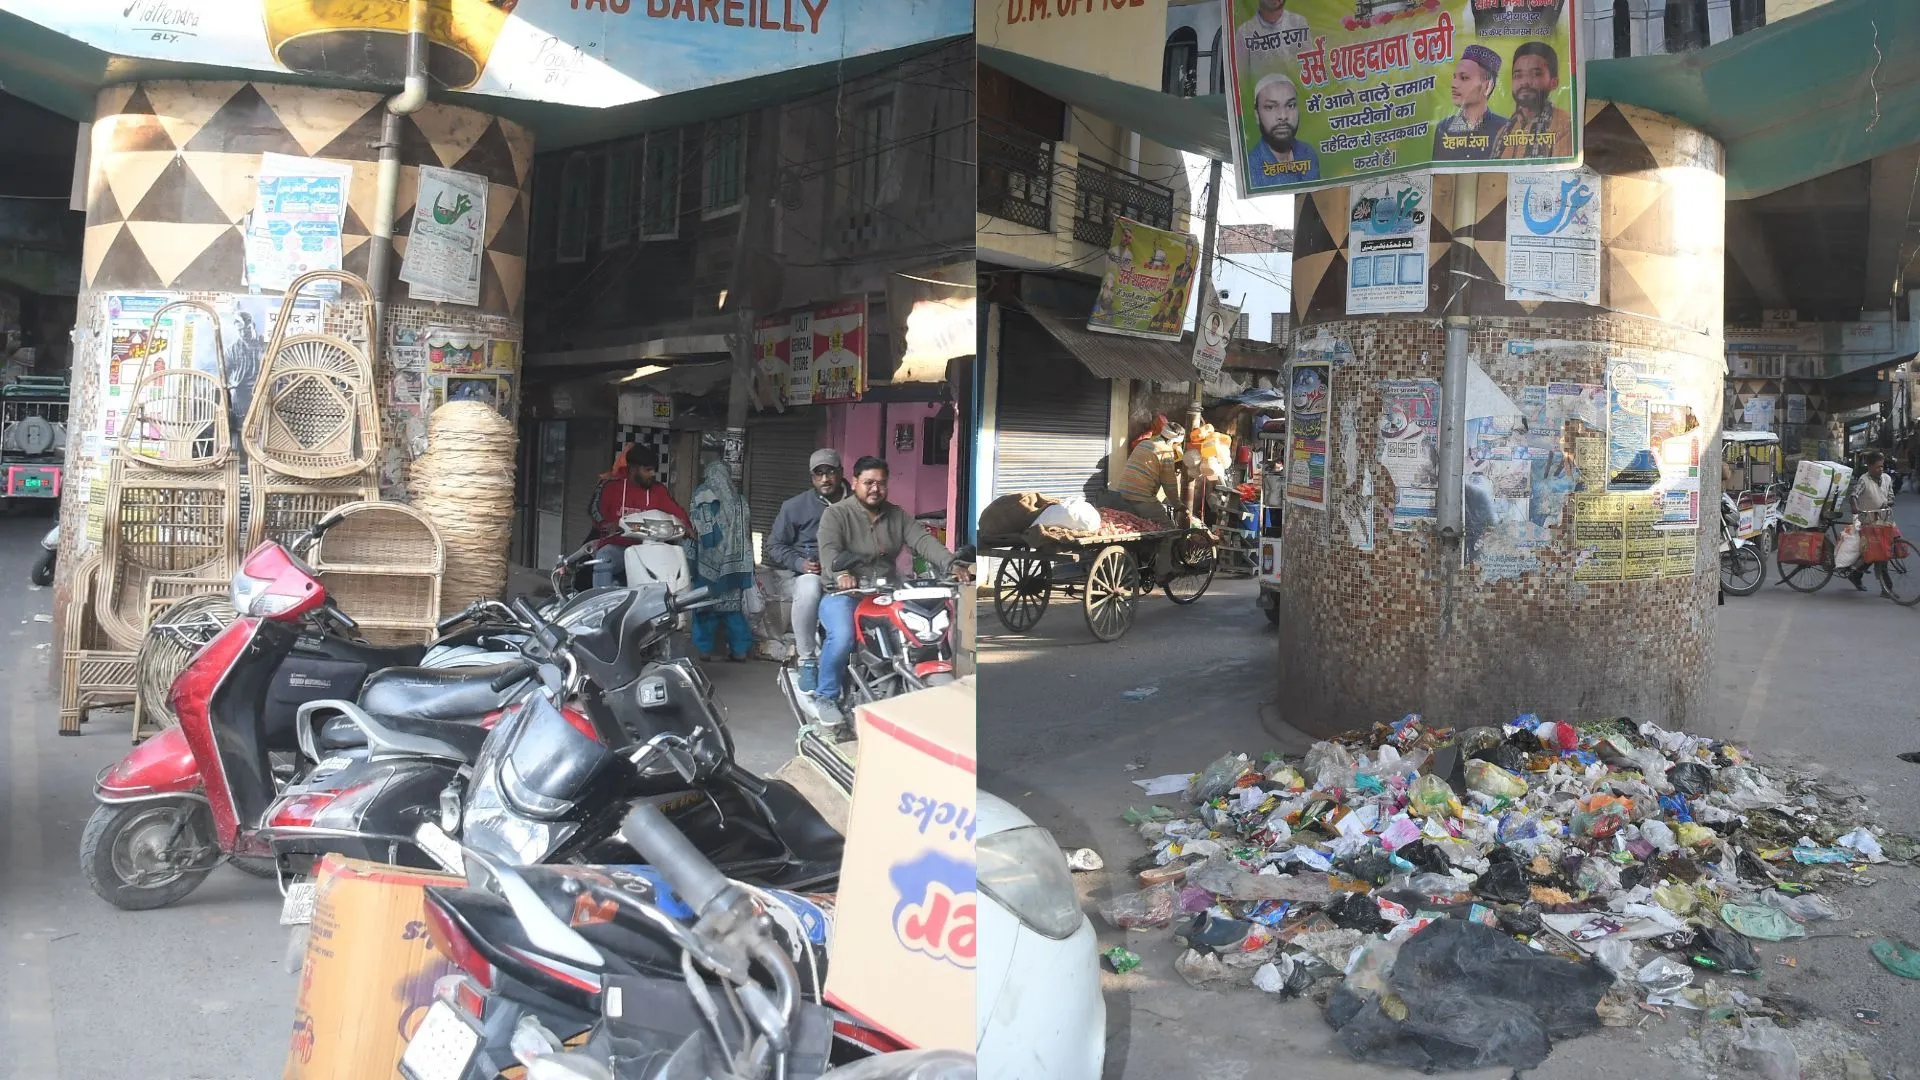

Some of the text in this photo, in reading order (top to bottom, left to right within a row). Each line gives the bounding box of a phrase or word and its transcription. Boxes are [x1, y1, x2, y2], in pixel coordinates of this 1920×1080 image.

[647, 0, 829, 34] BAREILLY
[1245, 31, 1281, 51] फैसल
[1329, 33, 1410, 80] शाहदाना
[1413, 11, 1455, 61] वली
[1306, 76, 1436, 113] में आने वाले तमाम
[1329, 102, 1415, 129] जायरीनों का
[1320, 122, 1428, 153] तहेदिल से इस्तकबाल
[1443, 133, 1467, 149] रेहान
[1503, 130, 1534, 146] शाकिर
[1354, 153, 1380, 170] करते
[305, 312, 317, 325] में
[791, 336, 812, 352] GENERAL
[793, 356, 809, 371] STORE
[294, 884, 316, 900] UP2
